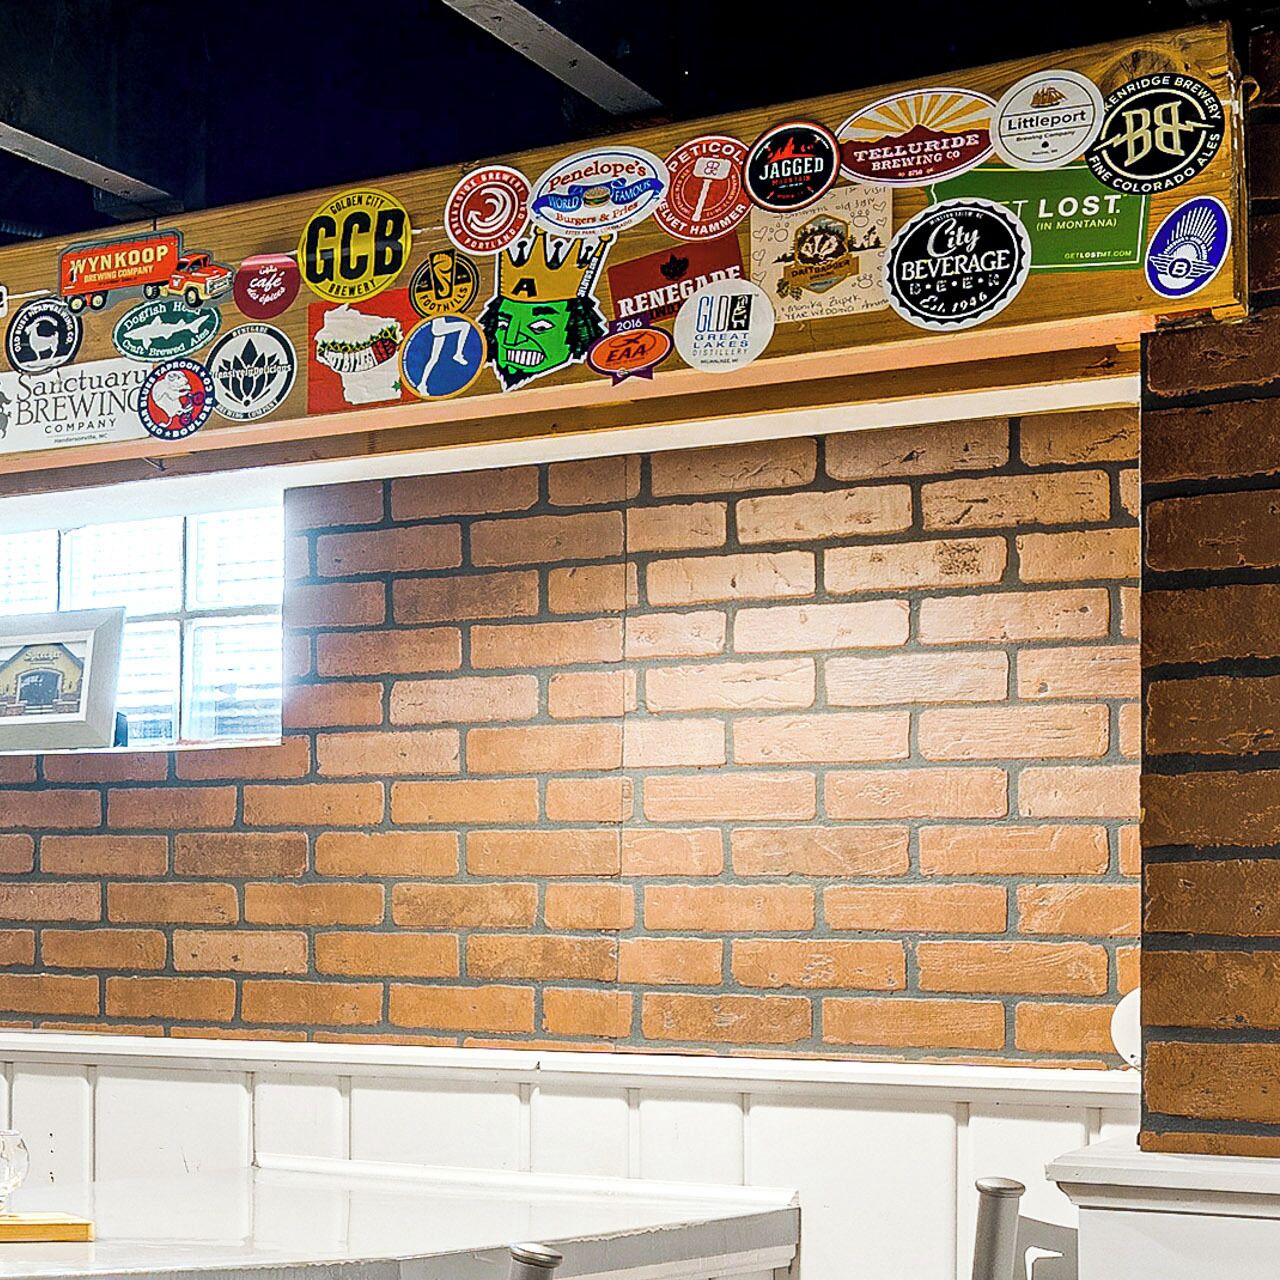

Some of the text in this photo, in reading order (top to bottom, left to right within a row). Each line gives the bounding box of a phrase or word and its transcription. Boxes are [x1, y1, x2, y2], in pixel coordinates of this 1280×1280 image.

[1175, 77, 1221, 120] BREWERY
[1008, 111, 1085, 130] Littleport
[1016, 130, 1075, 142] Brewing Company
[854, 134, 980, 163] TELLURIDE
[872, 150, 960, 171] BREWING CO
[759, 157, 824, 180] JAGGED
[1090, 133, 1220, 192] FINE COLORADO ALES
[548, 161, 647, 192] Penelope's
[330, 195, 384, 215] GOLDEN CITY
[451, 172, 525, 235] BREAKSIDE BREWERY
[548, 180, 652, 209] WORLD FAMOUS
[555, 213, 596, 225] Burgers
[613, 201, 639, 219] Fries
[657, 197, 747, 234] ELVET HAMMER
[1038, 195, 1121, 219] LOST.
[1037, 219, 1117, 231] (IN MONTANA)
[305, 209, 406, 284] GCB
[927, 218, 980, 257] City
[71, 245, 168, 274] WYNKOOP
[902, 250, 1010, 280] BEVERAGE
[83, 271, 117, 283] BREWING
[117, 265, 153, 278] COMPANY
[250, 271, 285, 292] café
[329, 280, 376, 297] BREWERY
[420, 287, 467, 311] FOOTHILLS
[511, 278, 537, 297] A
[15, 315, 30, 335] BUST
[124, 305, 166, 331] Dogfish
[617, 319, 642, 331] 2016
[696, 296, 729, 332] GLD
[122, 328, 210, 357] Craft Brewed Ales
[694, 333, 748, 341] GREAT
[694, 340, 748, 349] LAKES
[606, 345, 646, 362] EAA
[17, 370, 148, 400] Sanctuary
[140, 361, 200, 435] OSKAR BLUES TAPROOM
[44, 418, 117, 434] COMPANY
[172, 398, 213, 438] BOULDER
